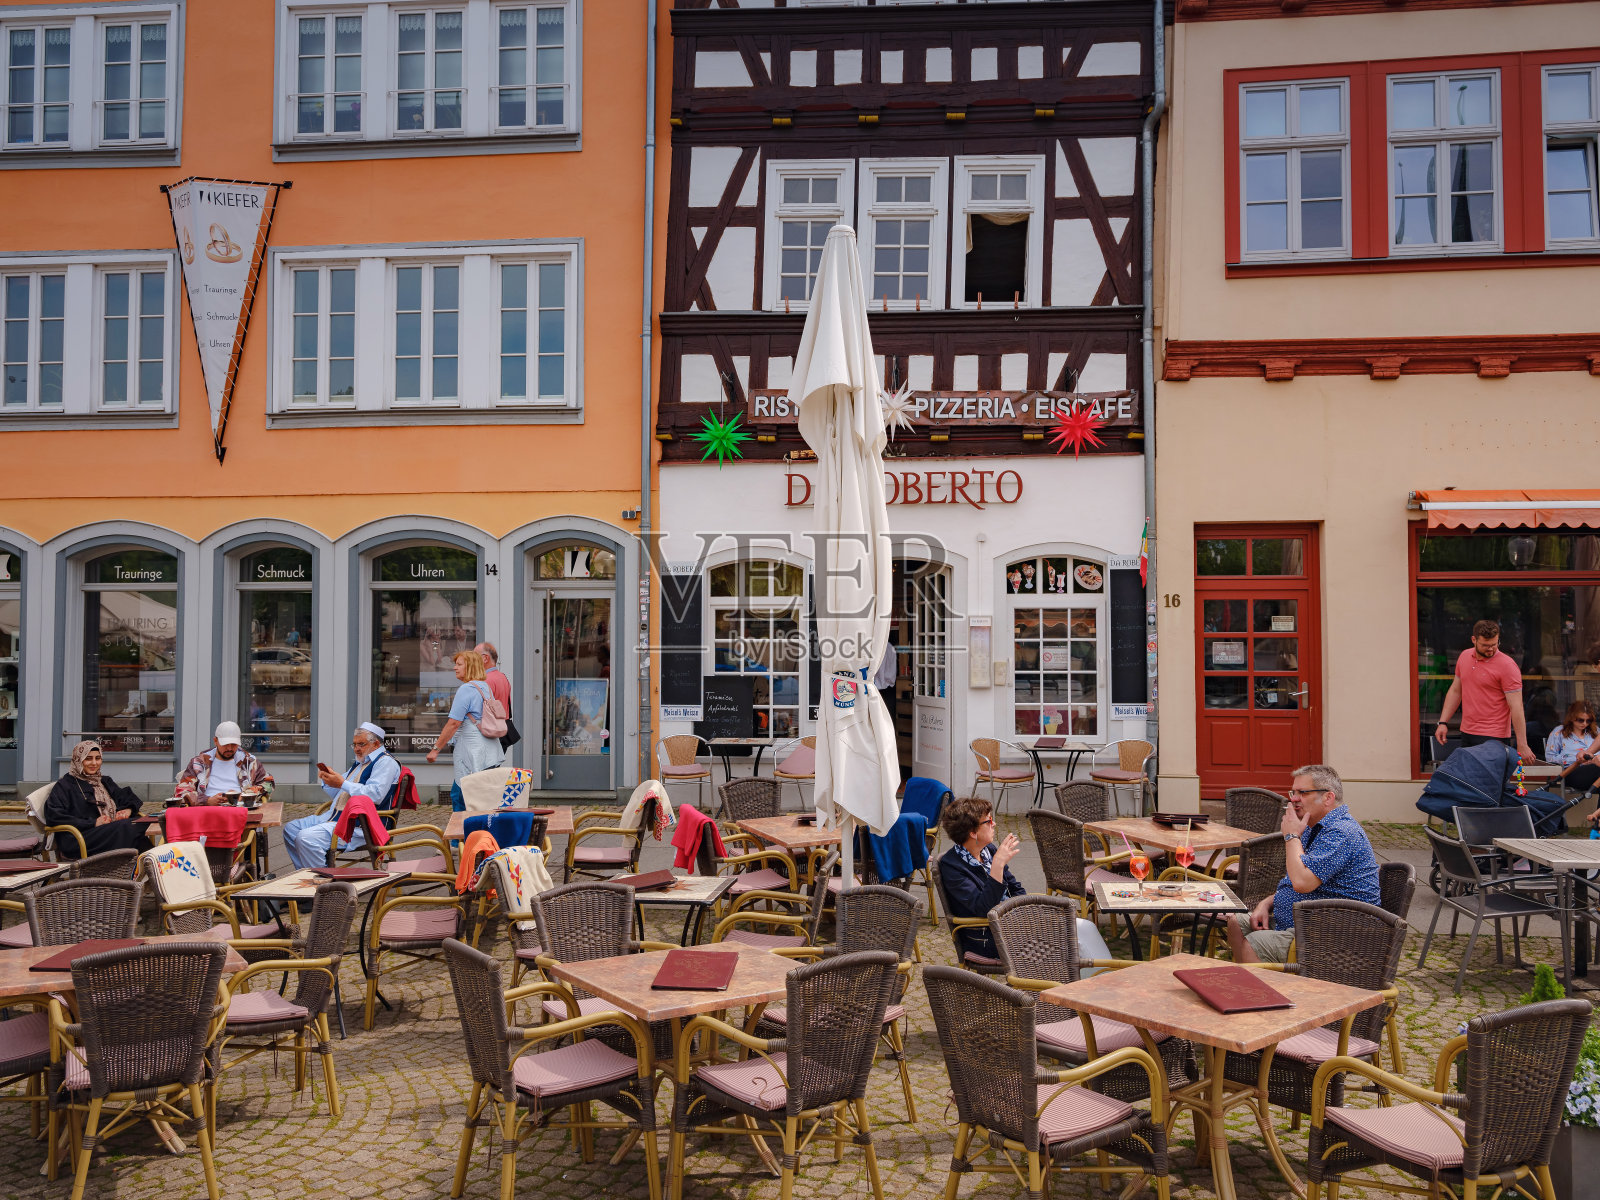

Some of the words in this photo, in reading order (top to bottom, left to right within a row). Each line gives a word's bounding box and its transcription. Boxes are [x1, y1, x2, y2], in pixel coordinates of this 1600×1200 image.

[214, 192, 260, 209] KIEFER
[204, 284, 238, 295] Trauringe
[206, 311, 238, 321] Schmuck
[209, 339, 231, 348] Uhren
[914, 396, 1016, 419] PIZZERIA
[884, 468, 1023, 510] OBERTO
[114, 565, 162, 581] Trauringe
[257, 564, 305, 579] Schmuck
[410, 563, 445, 577] Uhren
[485, 564, 498, 576] 14
[1164, 594, 1181, 608] 16
